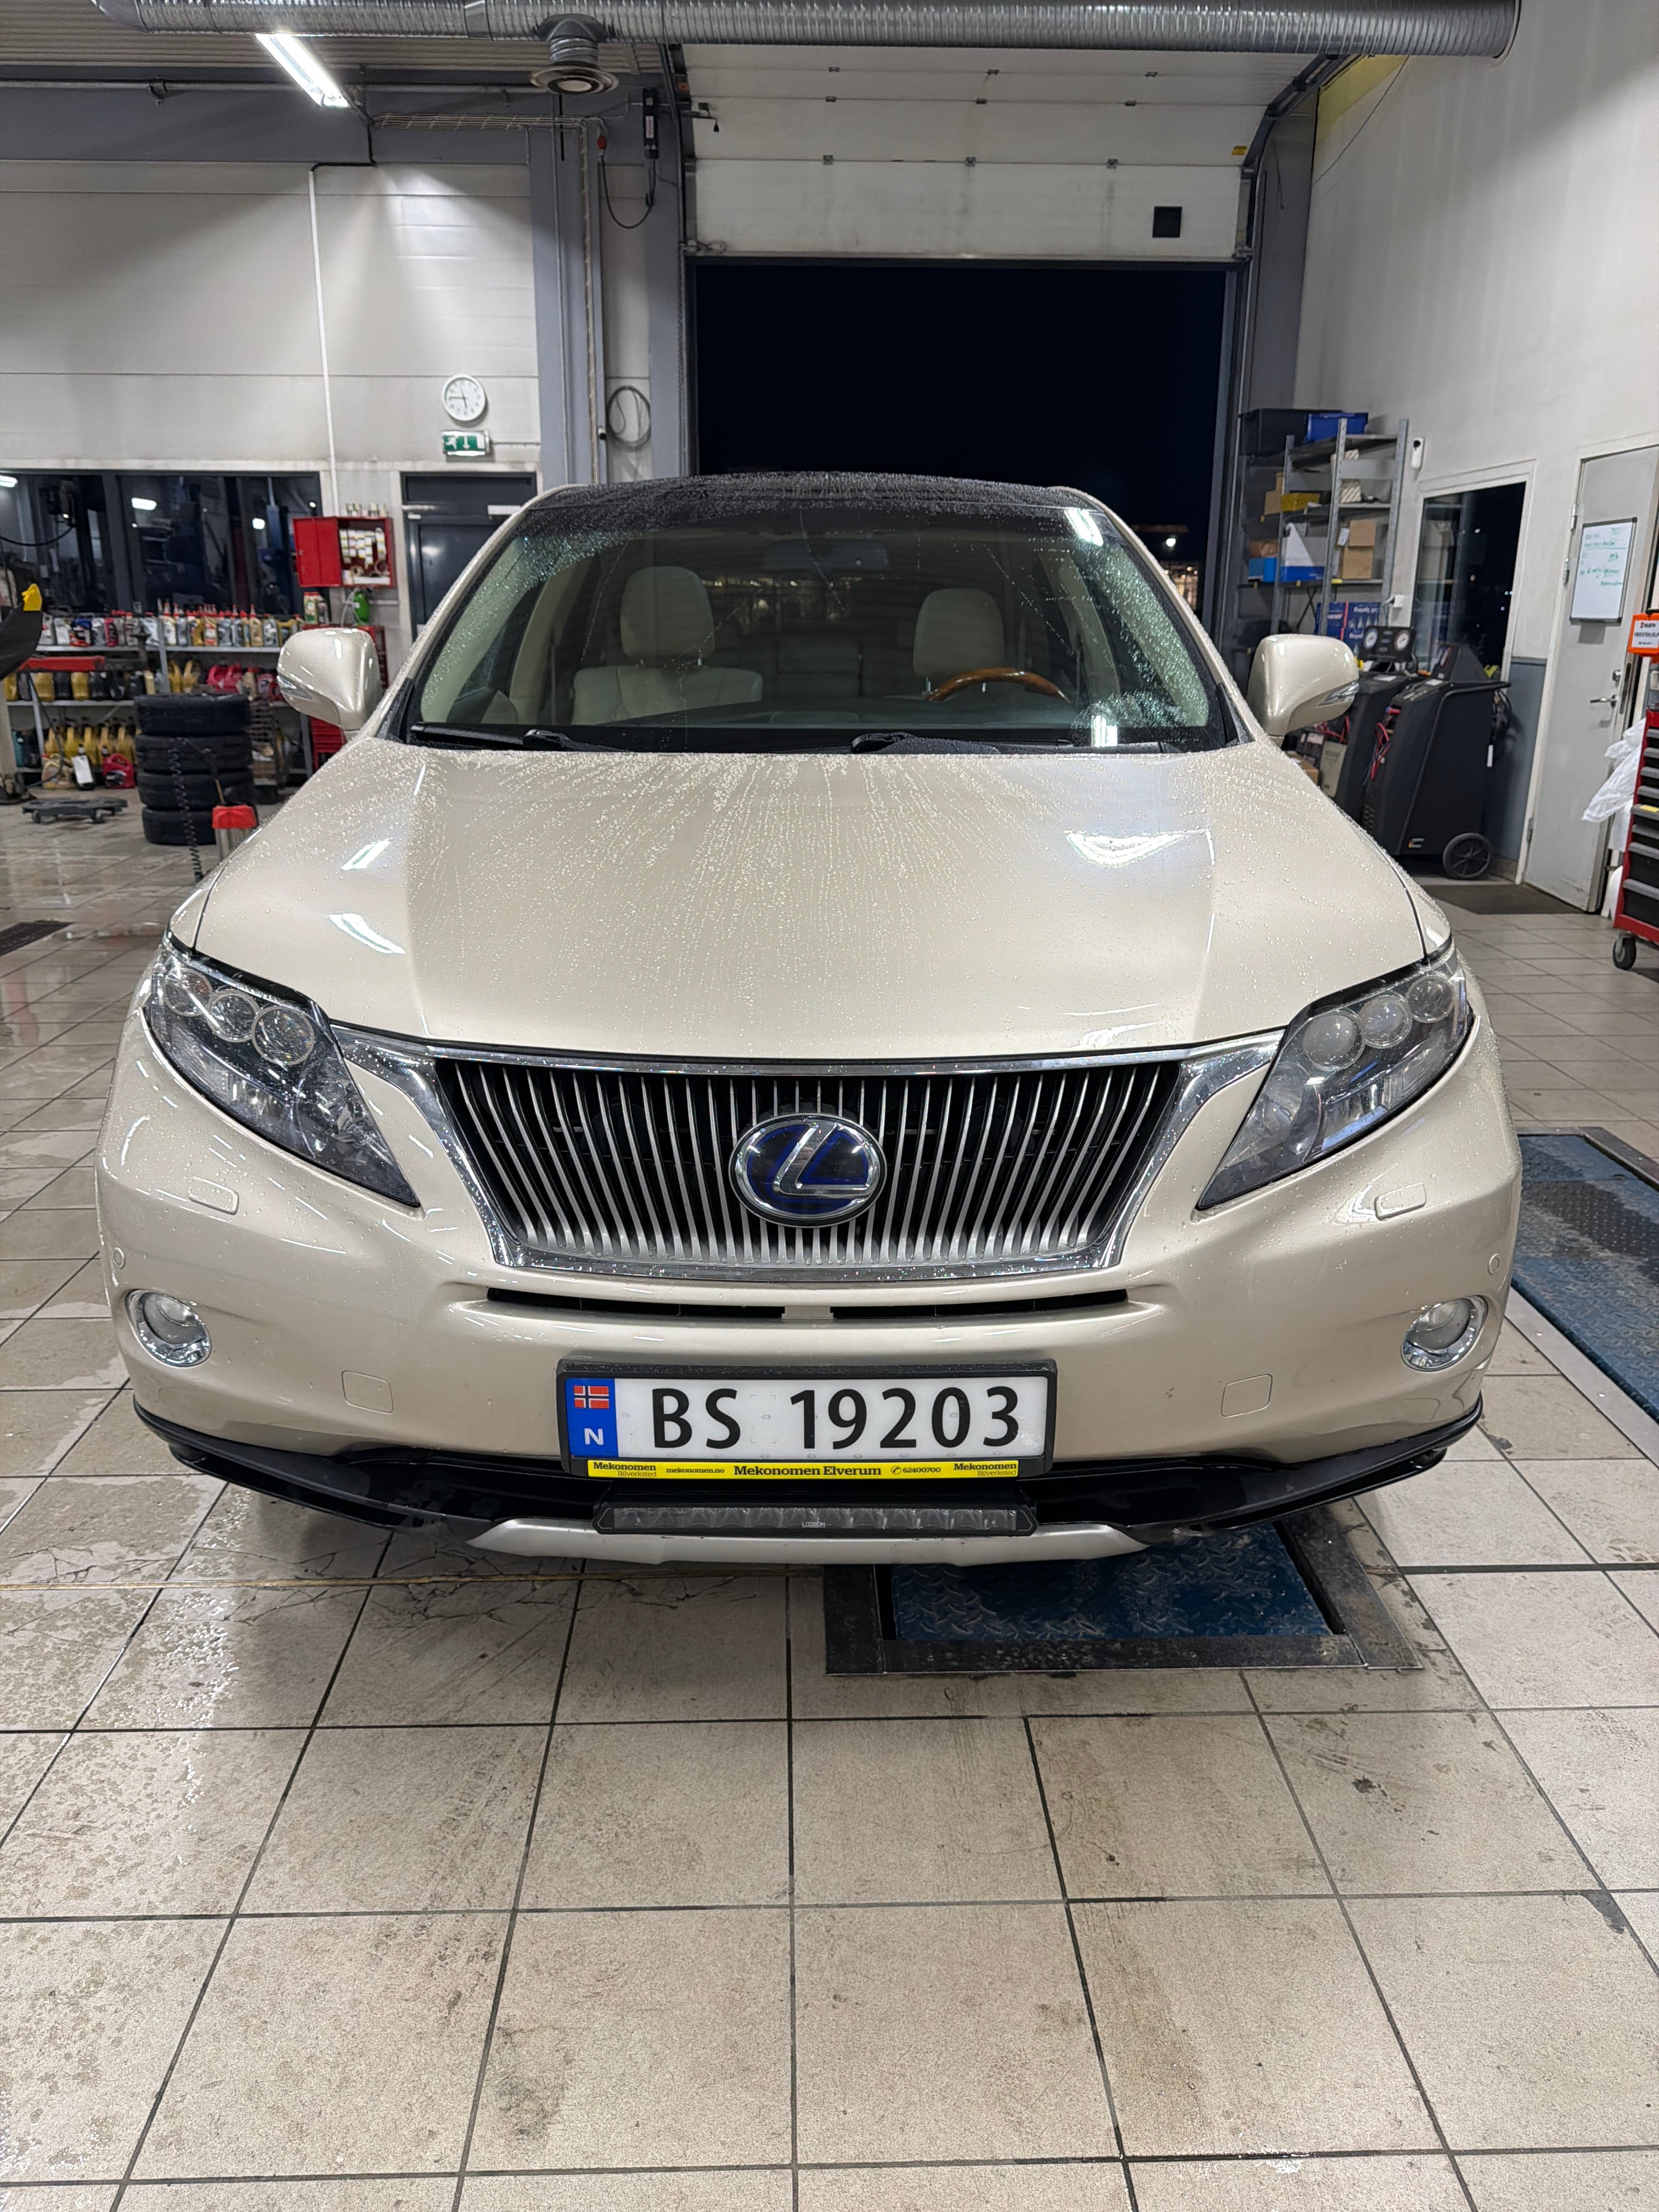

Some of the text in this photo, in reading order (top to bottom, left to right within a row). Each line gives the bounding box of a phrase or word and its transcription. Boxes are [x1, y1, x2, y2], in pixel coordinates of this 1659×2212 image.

[652, 1386, 1019, 1449] BS 19203
[584, 1427, 603, 1445] N
[593, 1462, 656, 1471] Mekonomen
[733, 1466, 882, 1475] Mekonomen Elverum
